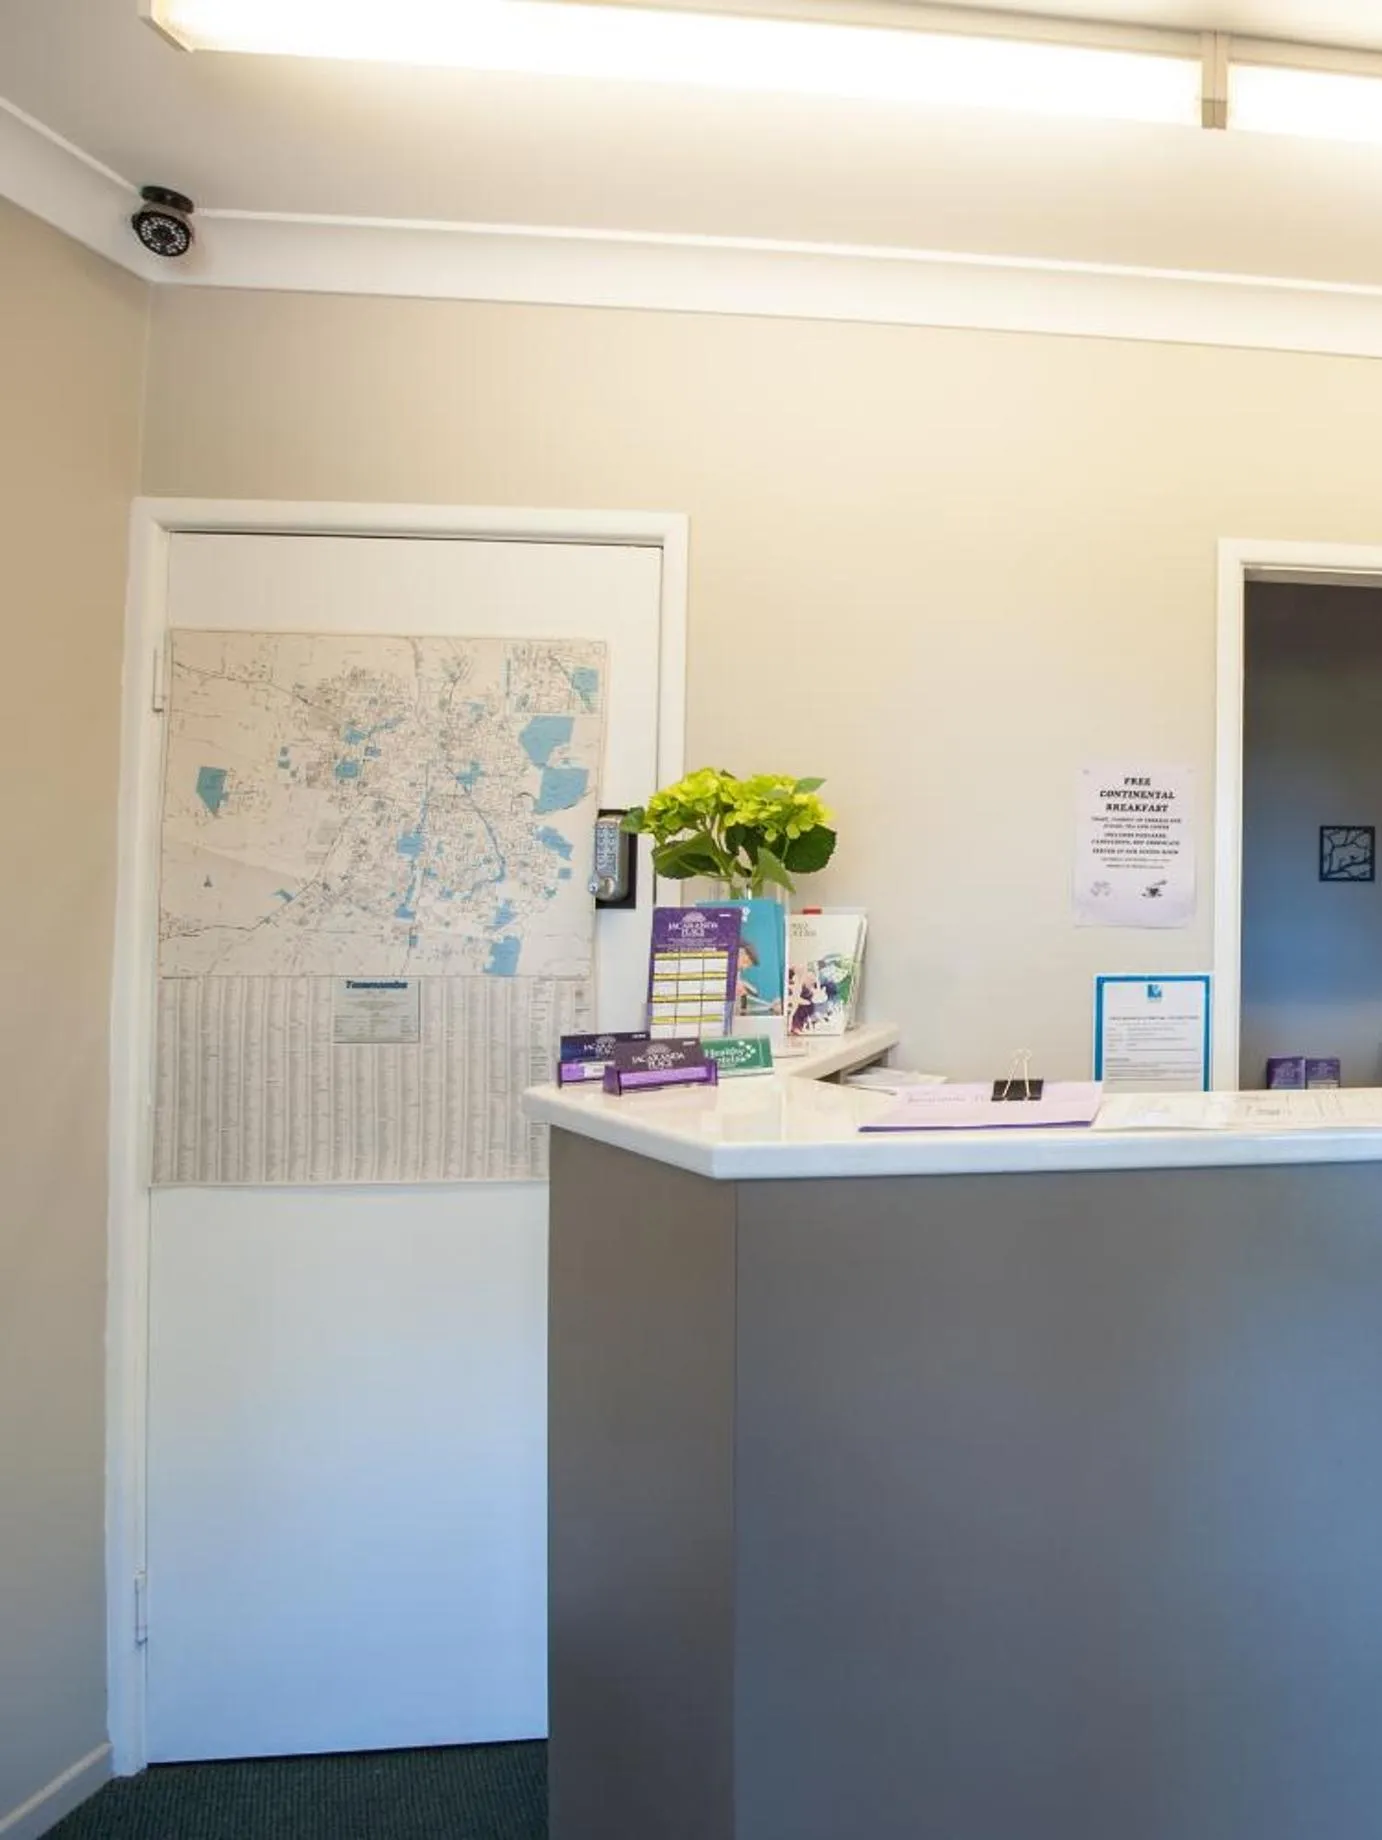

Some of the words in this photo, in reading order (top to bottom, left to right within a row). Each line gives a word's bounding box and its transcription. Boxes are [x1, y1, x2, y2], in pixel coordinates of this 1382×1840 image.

[1124, 777, 1151, 786] FREE
[1100, 790, 1176, 800] CONTINENTAL
[1106, 803, 1169, 813] BREAKFAST
